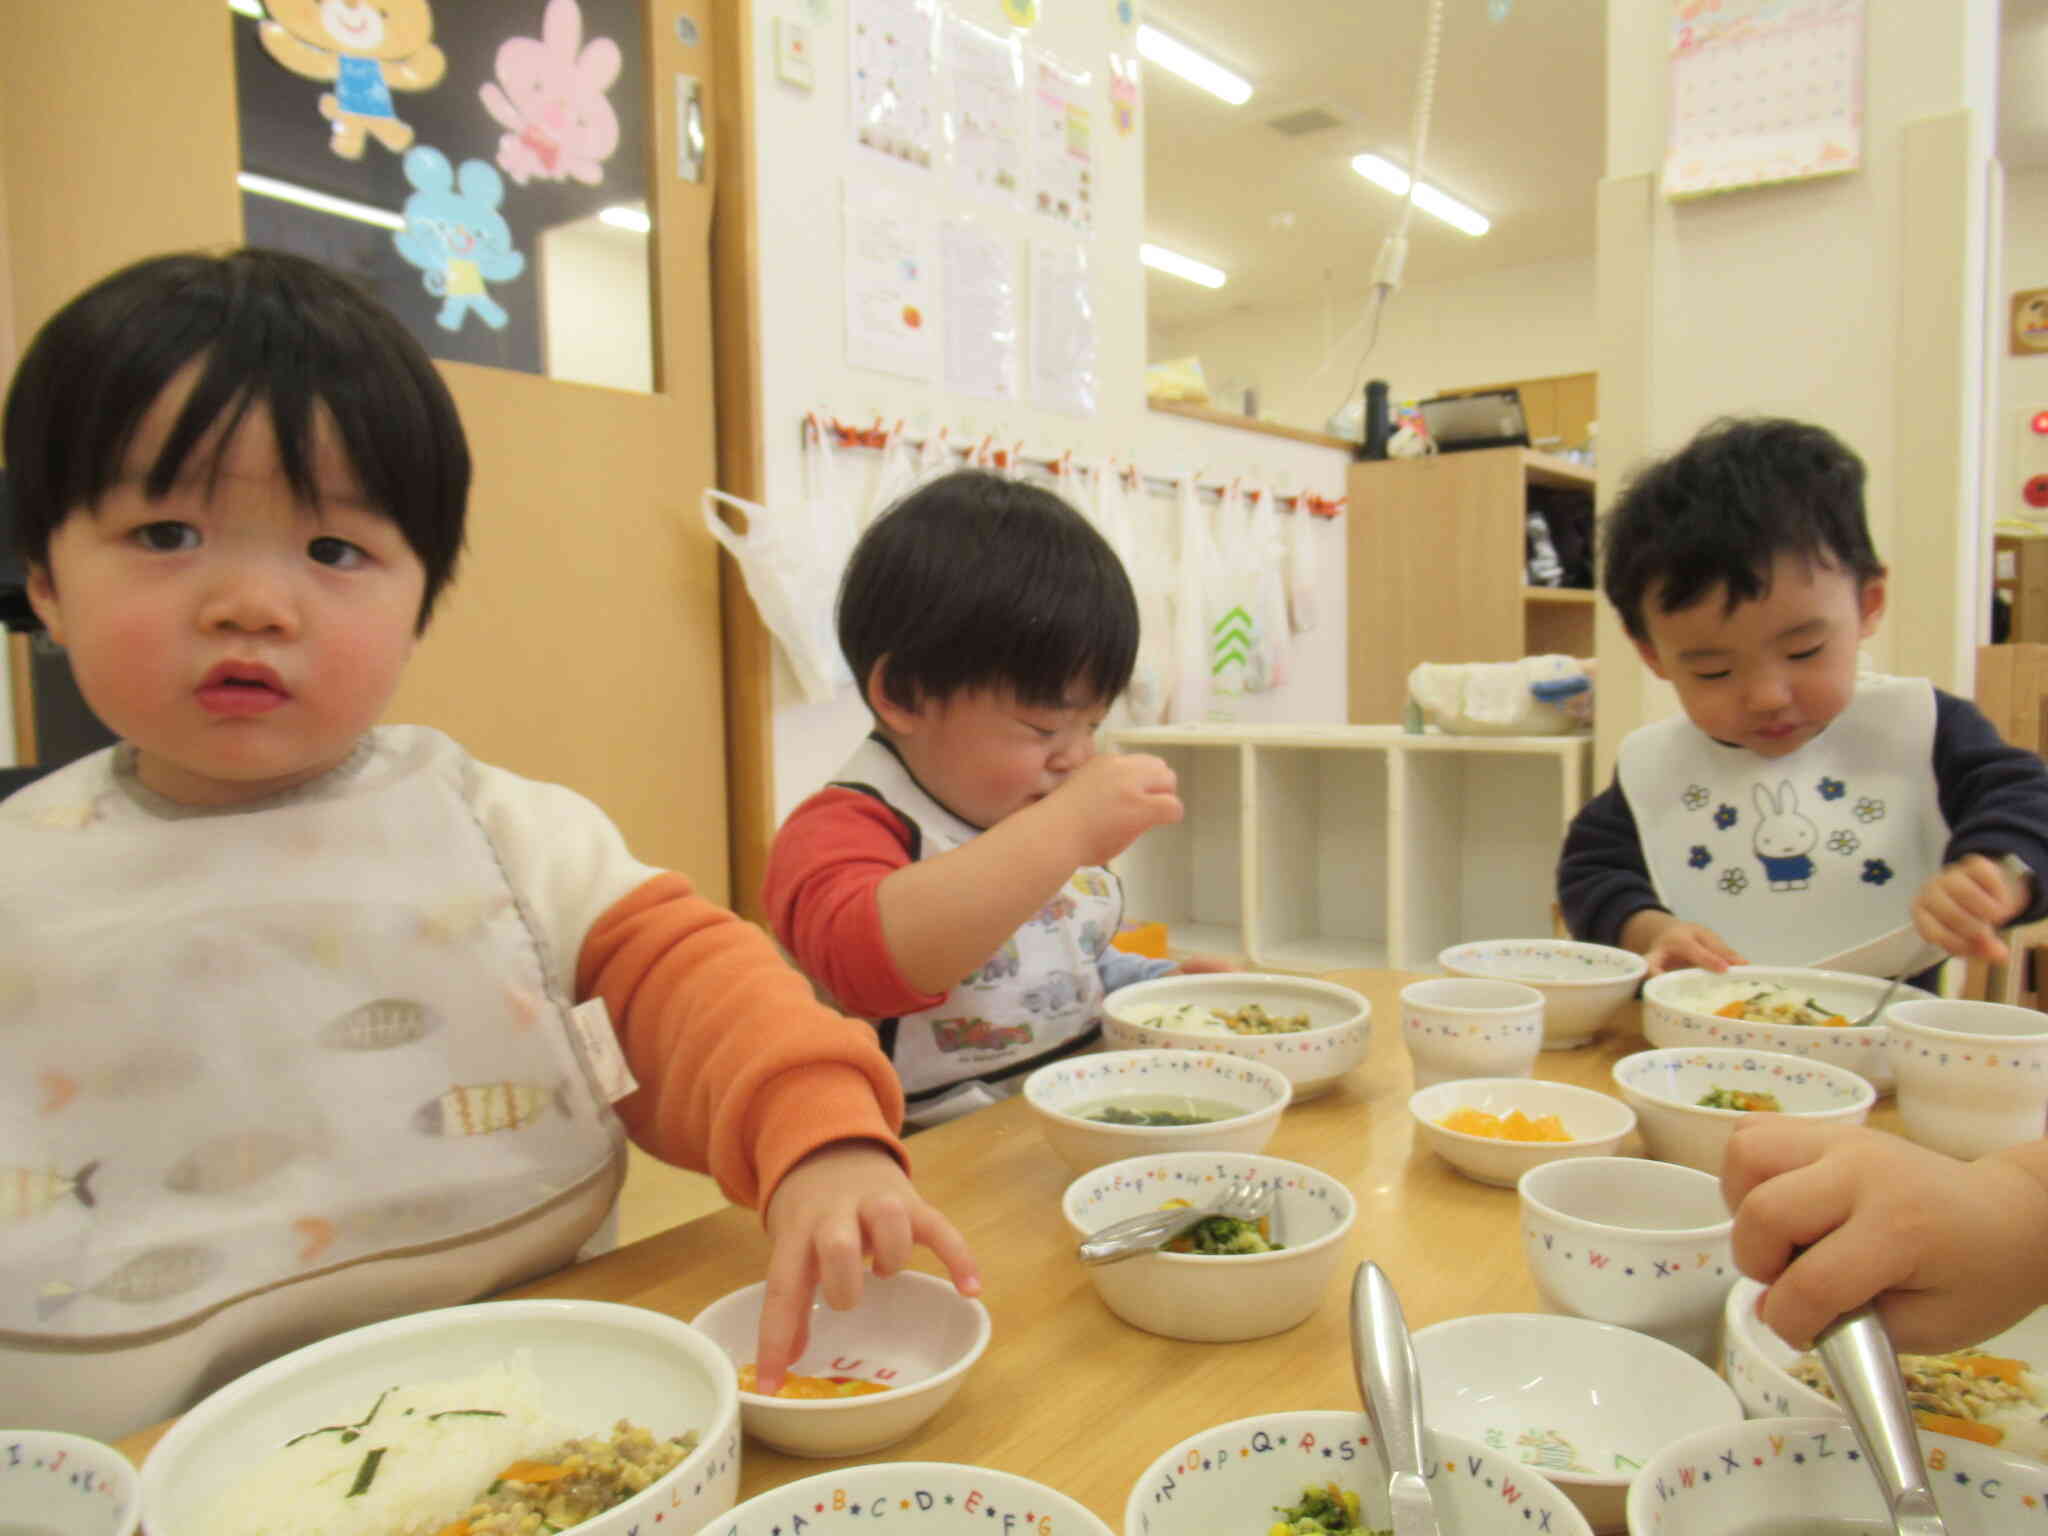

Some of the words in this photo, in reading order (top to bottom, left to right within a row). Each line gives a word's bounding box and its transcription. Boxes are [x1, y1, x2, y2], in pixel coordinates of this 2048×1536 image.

[1589, 1250, 1610, 1269] W
[1653, 1260, 1671, 1279] X
[1251, 1431, 1273, 1453] Q
[1298, 1431, 1316, 1455] R
[1339, 1440, 1355, 1461] S
[1467, 1455, 1483, 1477] V
[1502, 1471, 1522, 1504] W
[1538, 1508, 1552, 1534] X
[1678, 1465, 1696, 1489] W
[1719, 1447, 1741, 1476] X
[1767, 1434, 1785, 1457] Y
[1810, 1433, 1836, 1458] Z
[1926, 1447, 1947, 1471] B
[1980, 1478, 2003, 1499] C
[792, 1513, 809, 1536] A
[831, 1488, 848, 1512] B
[870, 1496, 888, 1518] C
[914, 1490, 934, 1511] D
[964, 1489, 985, 1514] E
[1003, 1513, 1016, 1536] F
